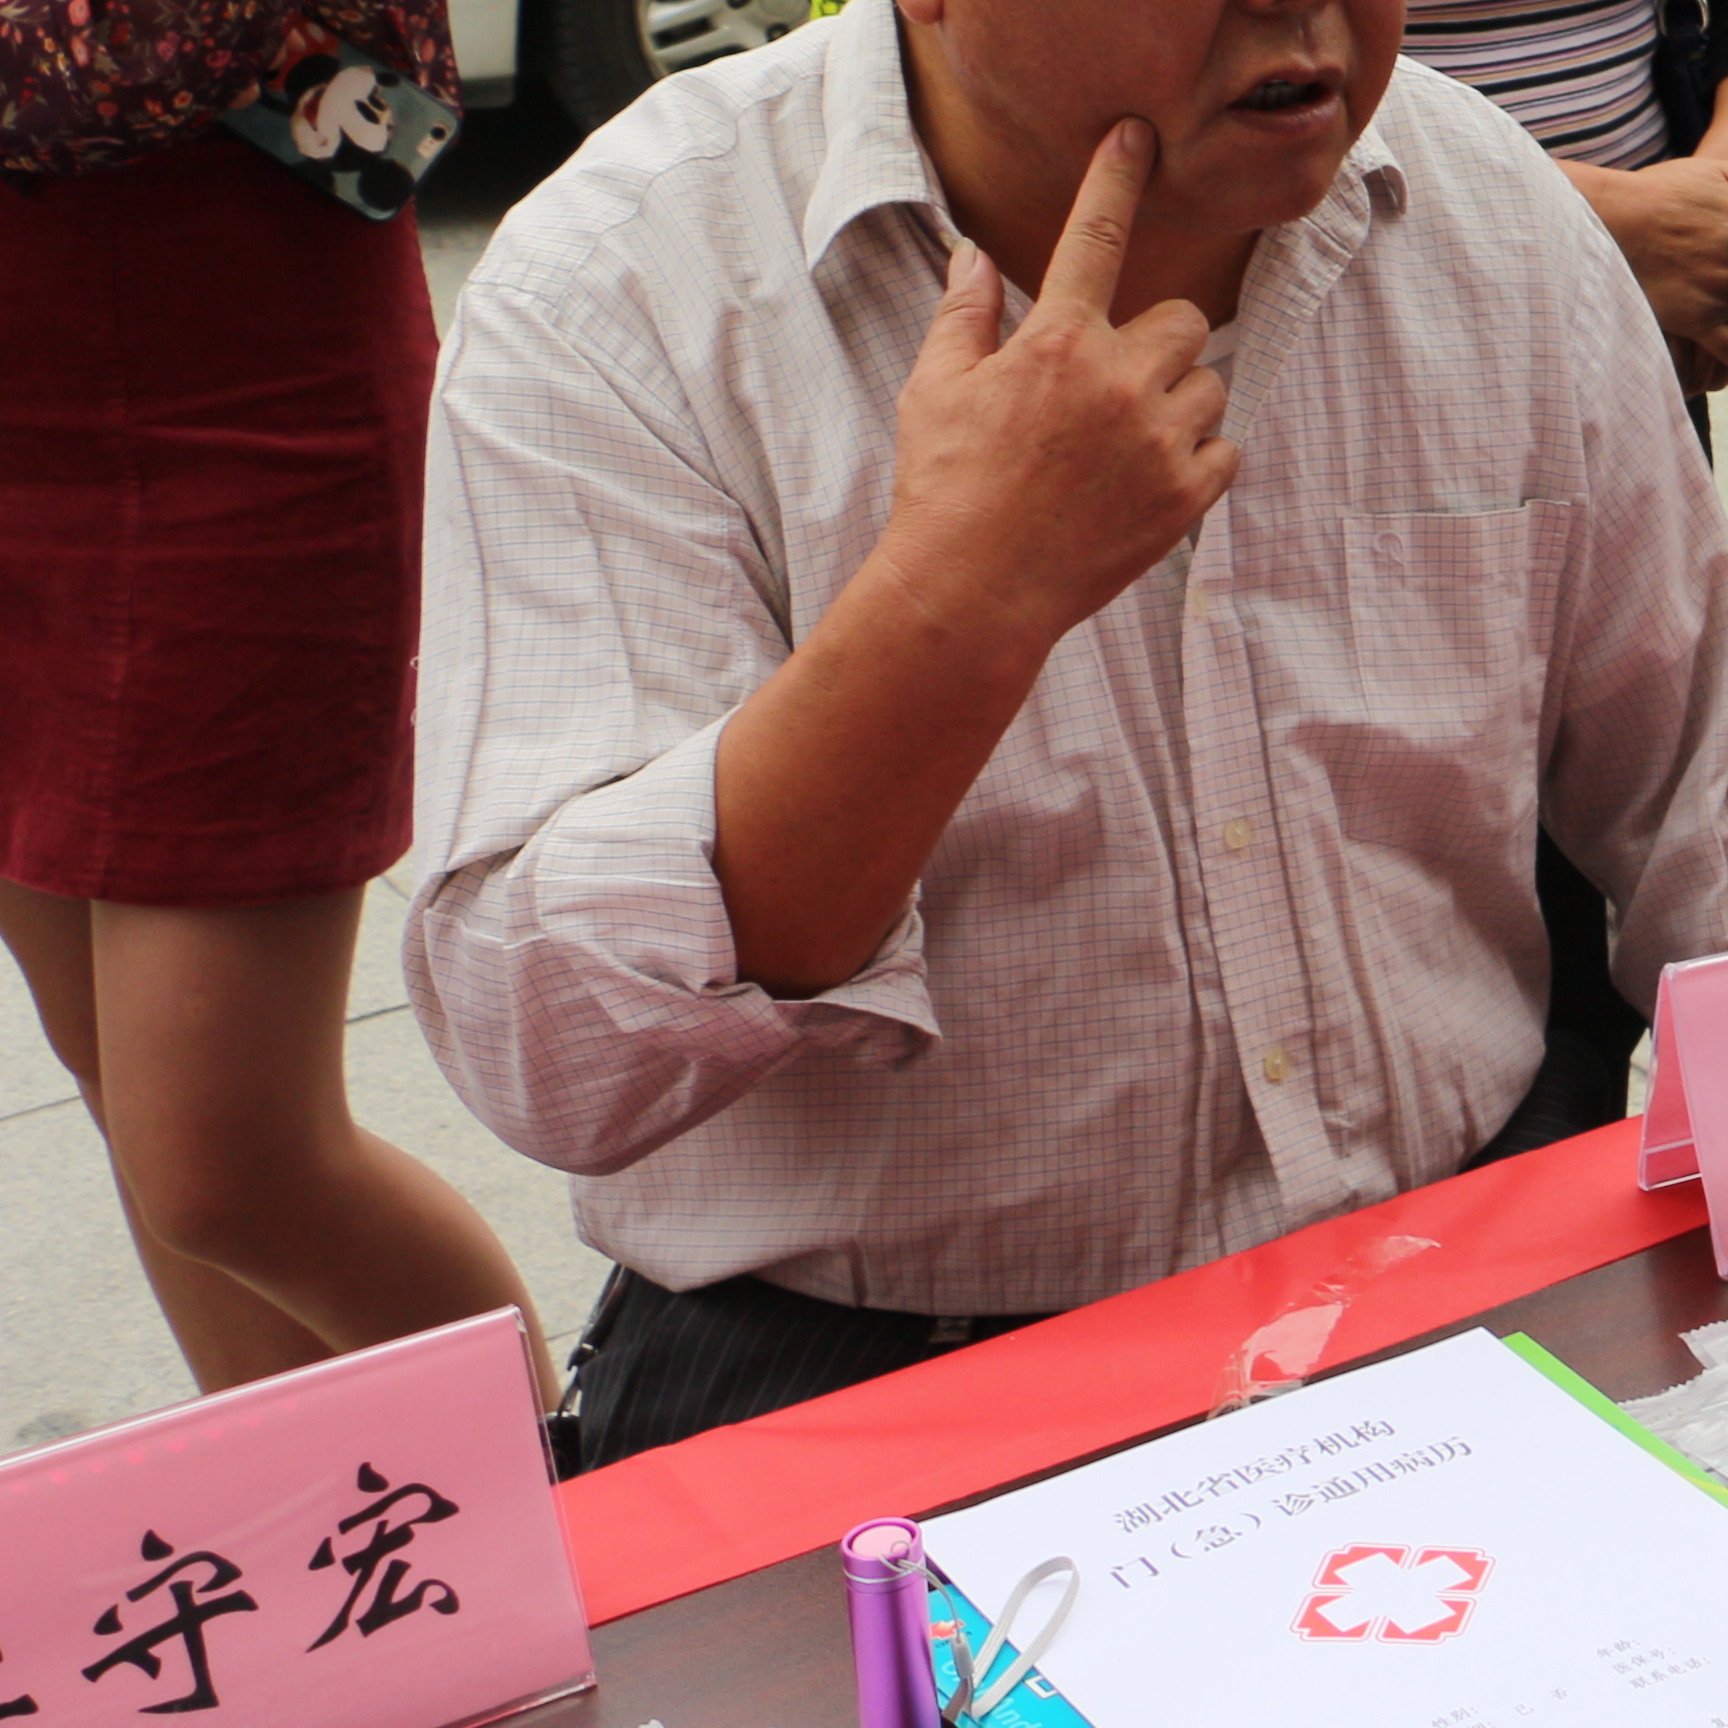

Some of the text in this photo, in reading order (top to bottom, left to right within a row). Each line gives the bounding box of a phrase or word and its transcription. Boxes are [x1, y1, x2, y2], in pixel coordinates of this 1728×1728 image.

[1112, 1418, 1397, 1535] 湖北省医疗机构
[0, 1462, 460, 1719] 守宏
